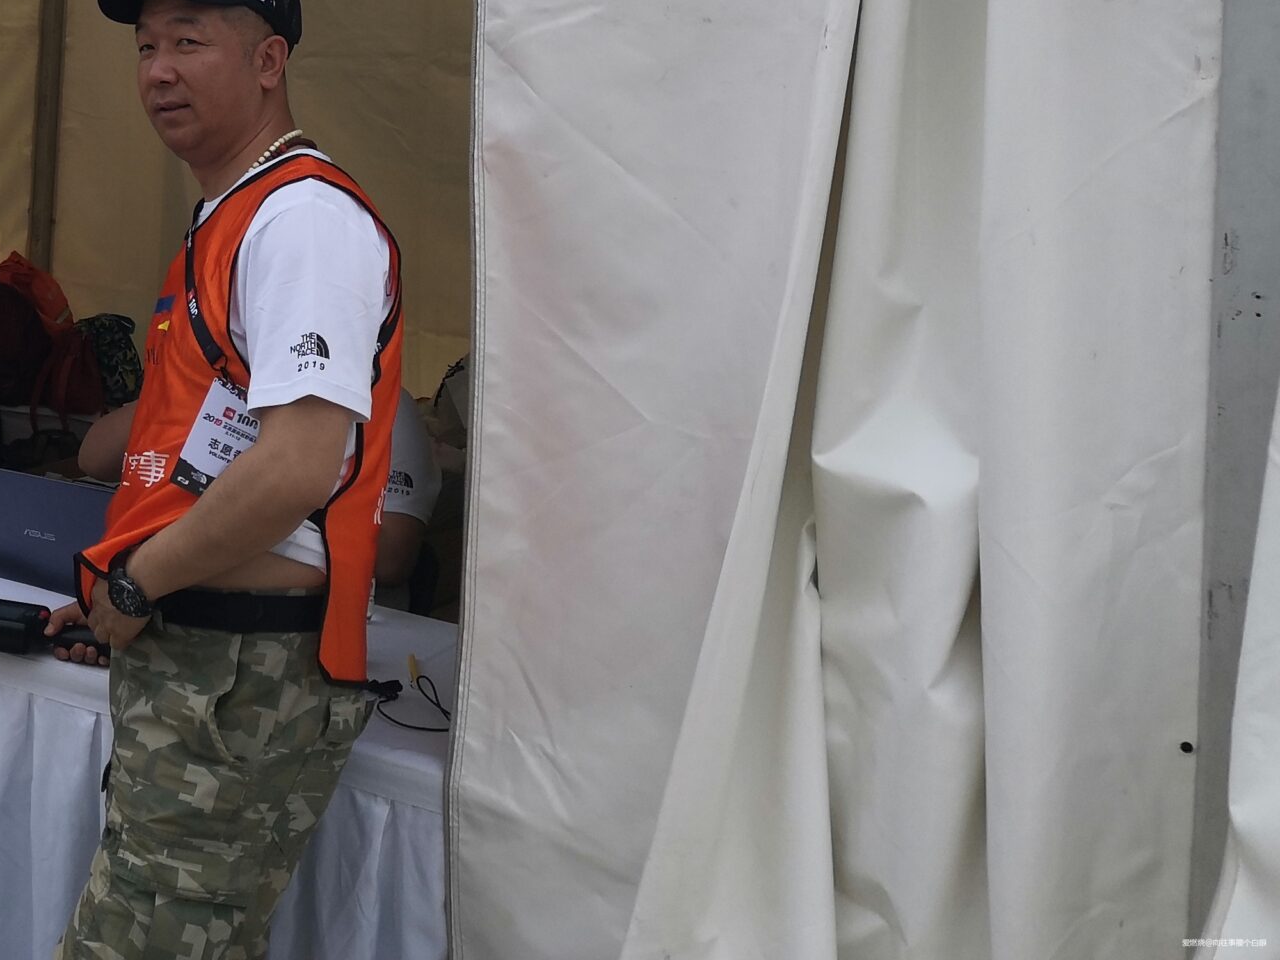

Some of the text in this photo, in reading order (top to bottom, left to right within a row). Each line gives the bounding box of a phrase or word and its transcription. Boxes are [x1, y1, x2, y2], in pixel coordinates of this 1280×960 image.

[301, 332, 317, 342] THE
[290, 339, 317, 354] NORTH
[297, 347, 317, 359] FACE
[297, 360, 326, 372] 2019
[24, 529, 56, 541] ASUS
